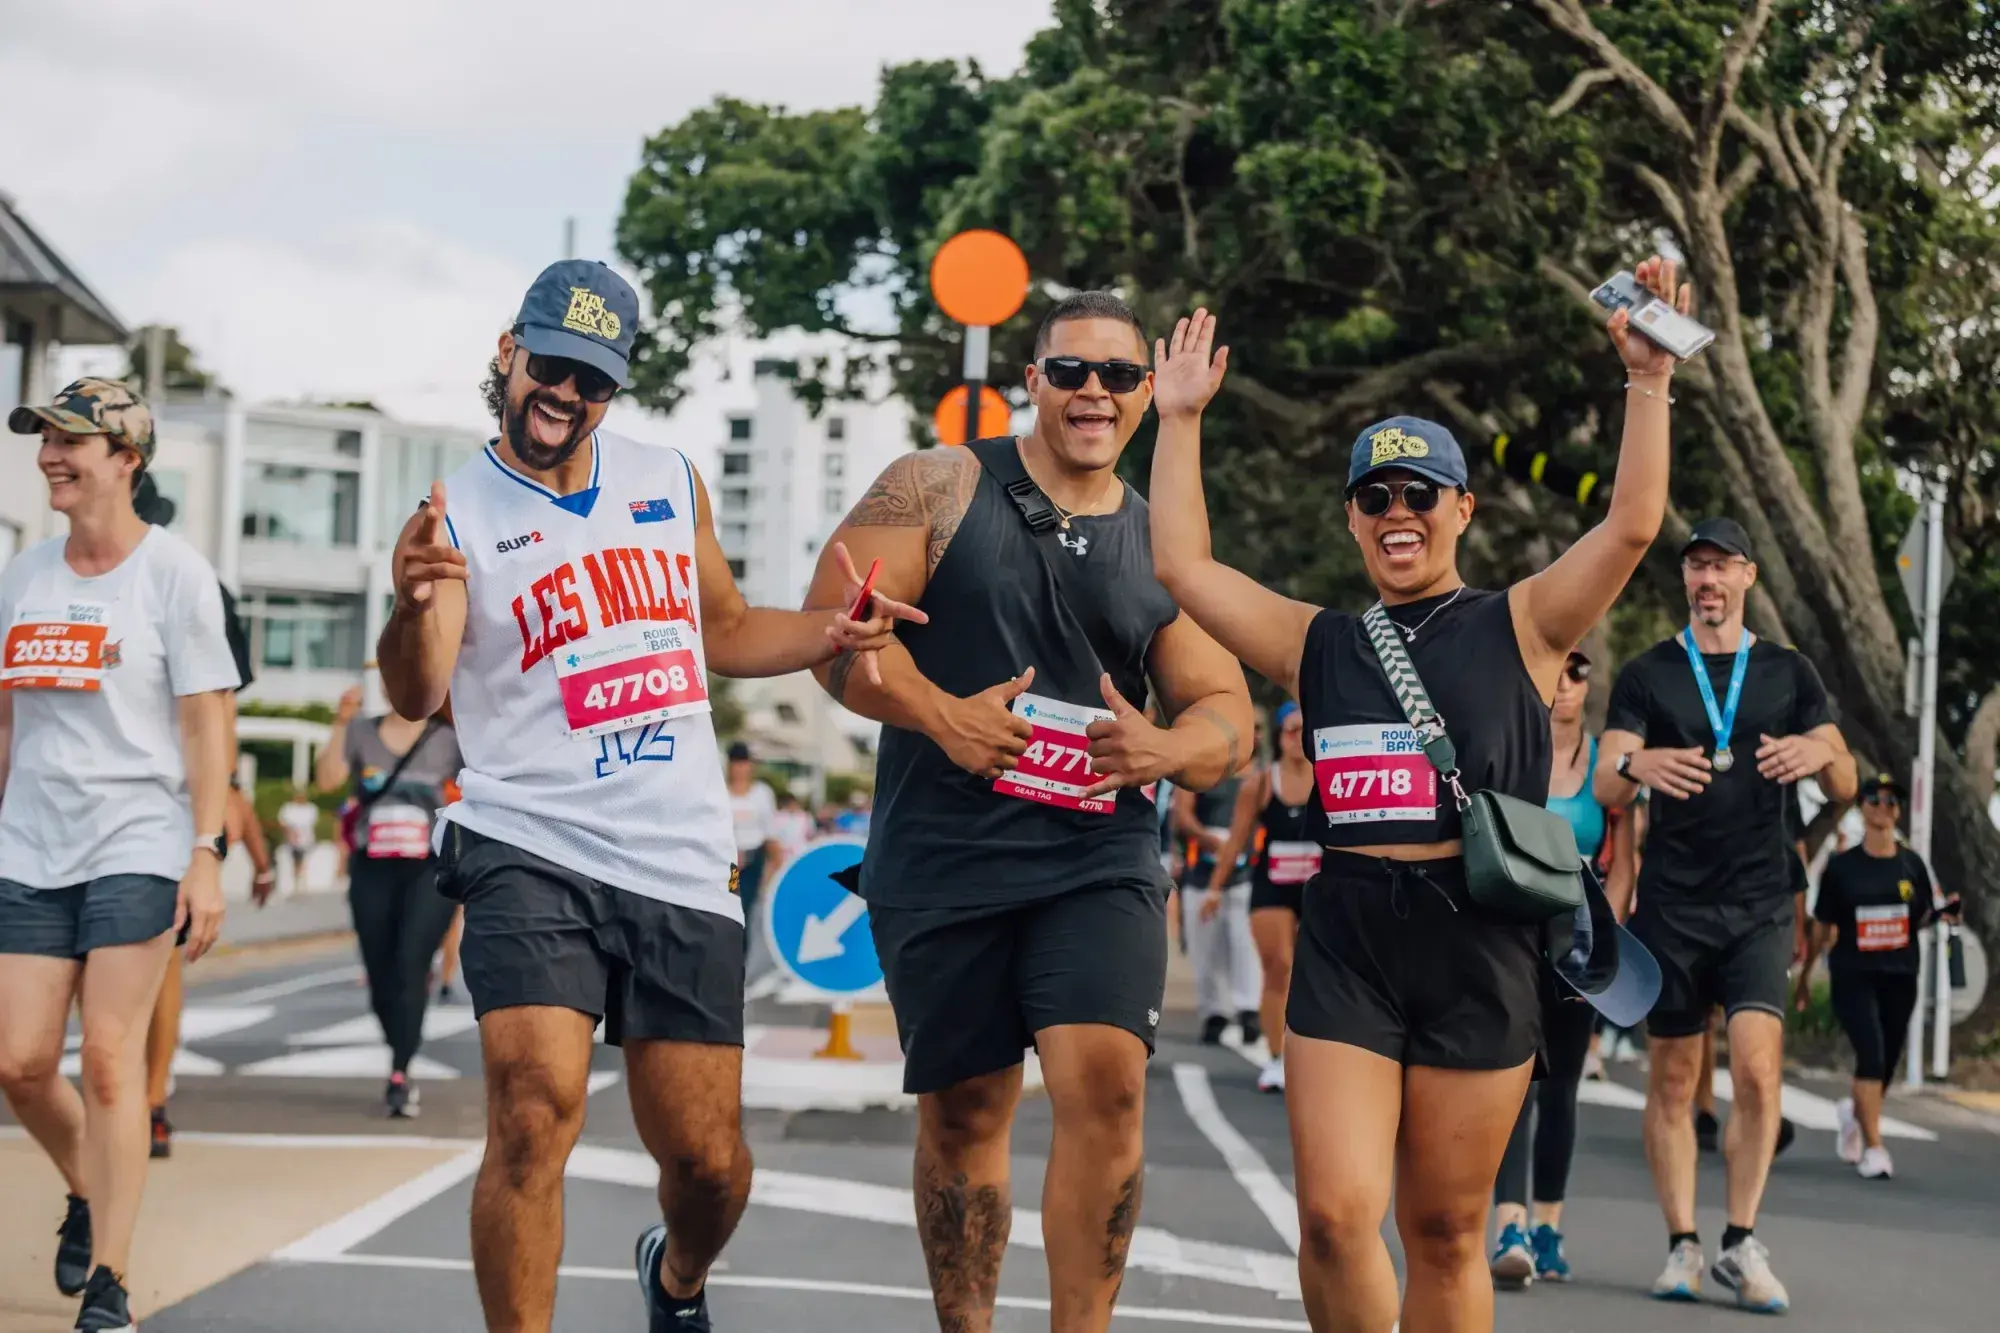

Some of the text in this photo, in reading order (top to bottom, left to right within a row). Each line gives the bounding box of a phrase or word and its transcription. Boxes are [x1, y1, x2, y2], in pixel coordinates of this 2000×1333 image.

[496, 531, 544, 554] SUP2
[511, 562, 589, 674] LES
[643, 627, 678, 641] ROUND
[13, 639, 90, 663] 20335
[651, 637, 682, 651] BAYS
[583, 664, 689, 710] 47708
[1038, 709, 1069, 723] Southern
[1386, 740, 1424, 752] BAYS
[1022, 739, 1104, 777] 4771
[1014, 785, 1052, 801] GEAR TAG
[1328, 768, 1412, 799] 47718
[1078, 800, 1103, 811] 47710
